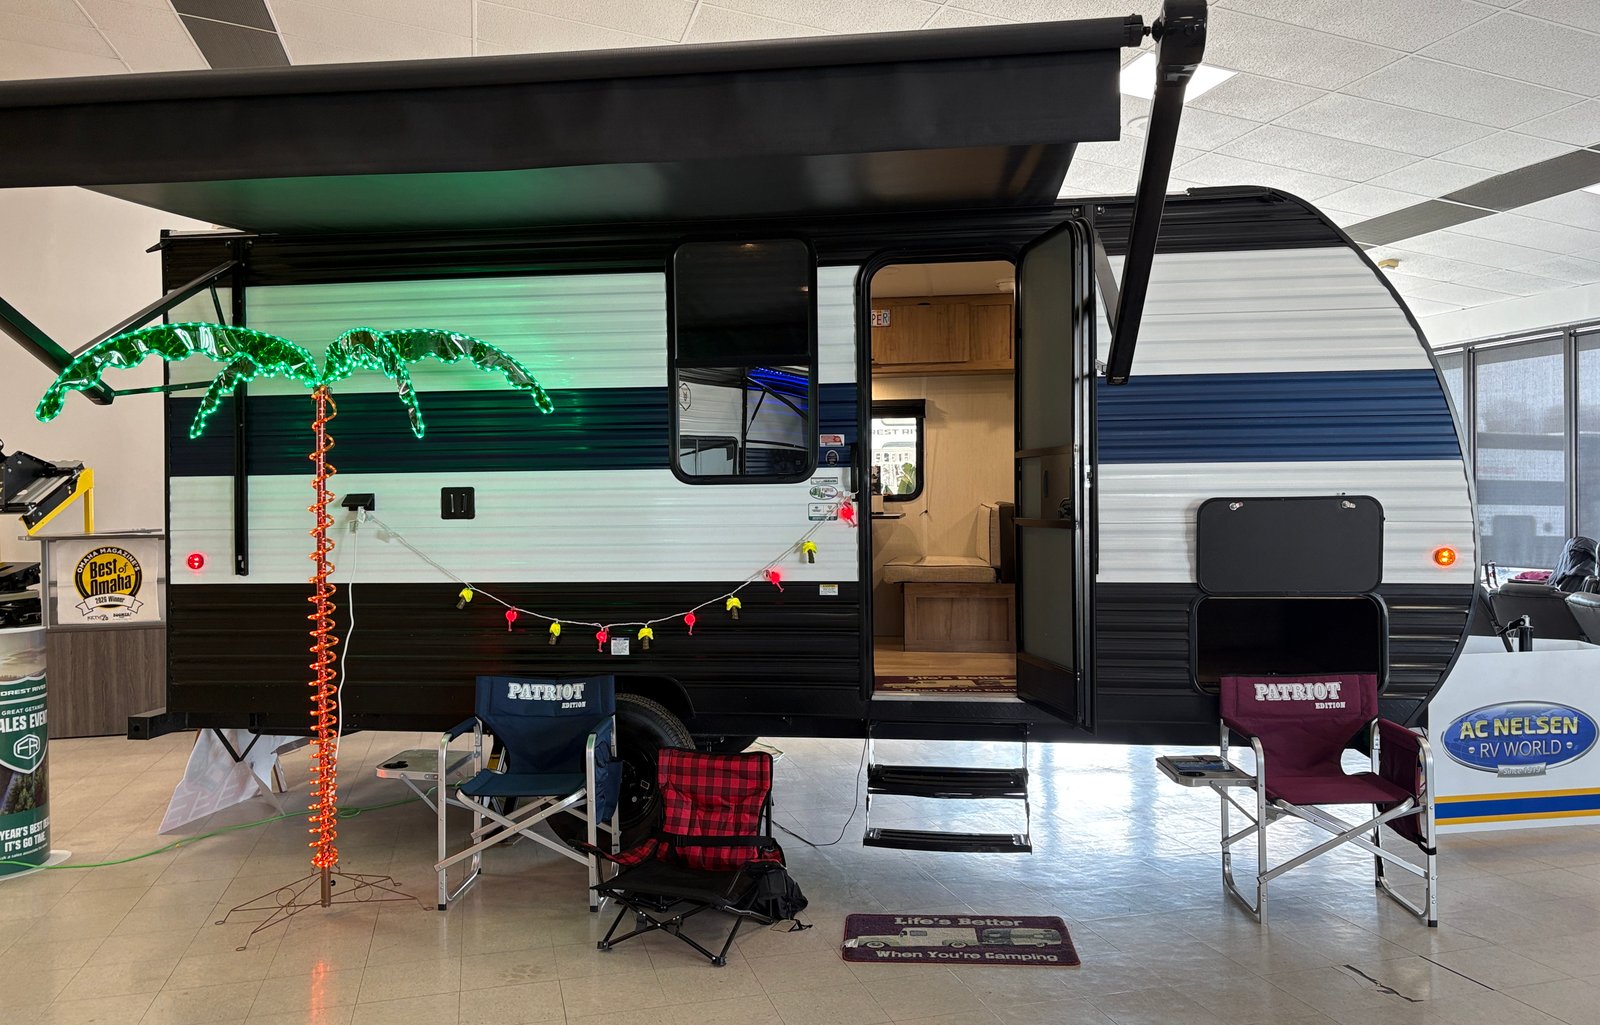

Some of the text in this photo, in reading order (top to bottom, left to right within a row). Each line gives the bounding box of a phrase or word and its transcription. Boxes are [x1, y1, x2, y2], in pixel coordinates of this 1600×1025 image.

[871, 312, 889, 326] PER
[77, 547, 140, 574] OMAHA MAGAZINE'S
[90, 558, 128, 579] Best of
[90, 574, 132, 596] Omaha
[108, 595, 126, 603] Winner
[0, 686, 31, 697] OREST
[507, 682, 585, 701] PATRIOT
[1253, 681, 1341, 701] PATRIOT
[1, 707, 24, 716] GREAT
[561, 701, 587, 709] EDITION
[1315, 702, 1346, 710] EDITION
[0, 715, 27, 733] ALES
[1459, 716, 1579, 740] AC NELSEN
[1480, 739, 1562, 759] RV WORLD
[1503, 767, 1522, 775] Since
[0, 825, 28, 841] YEAR'S
[29, 820, 43, 835] BEST
[4, 839, 21, 853] IT'S
[22, 836, 33, 849] GO
[894, 916, 1024, 926] Life's Better
[875, 950, 1058, 962] When You're Camping
